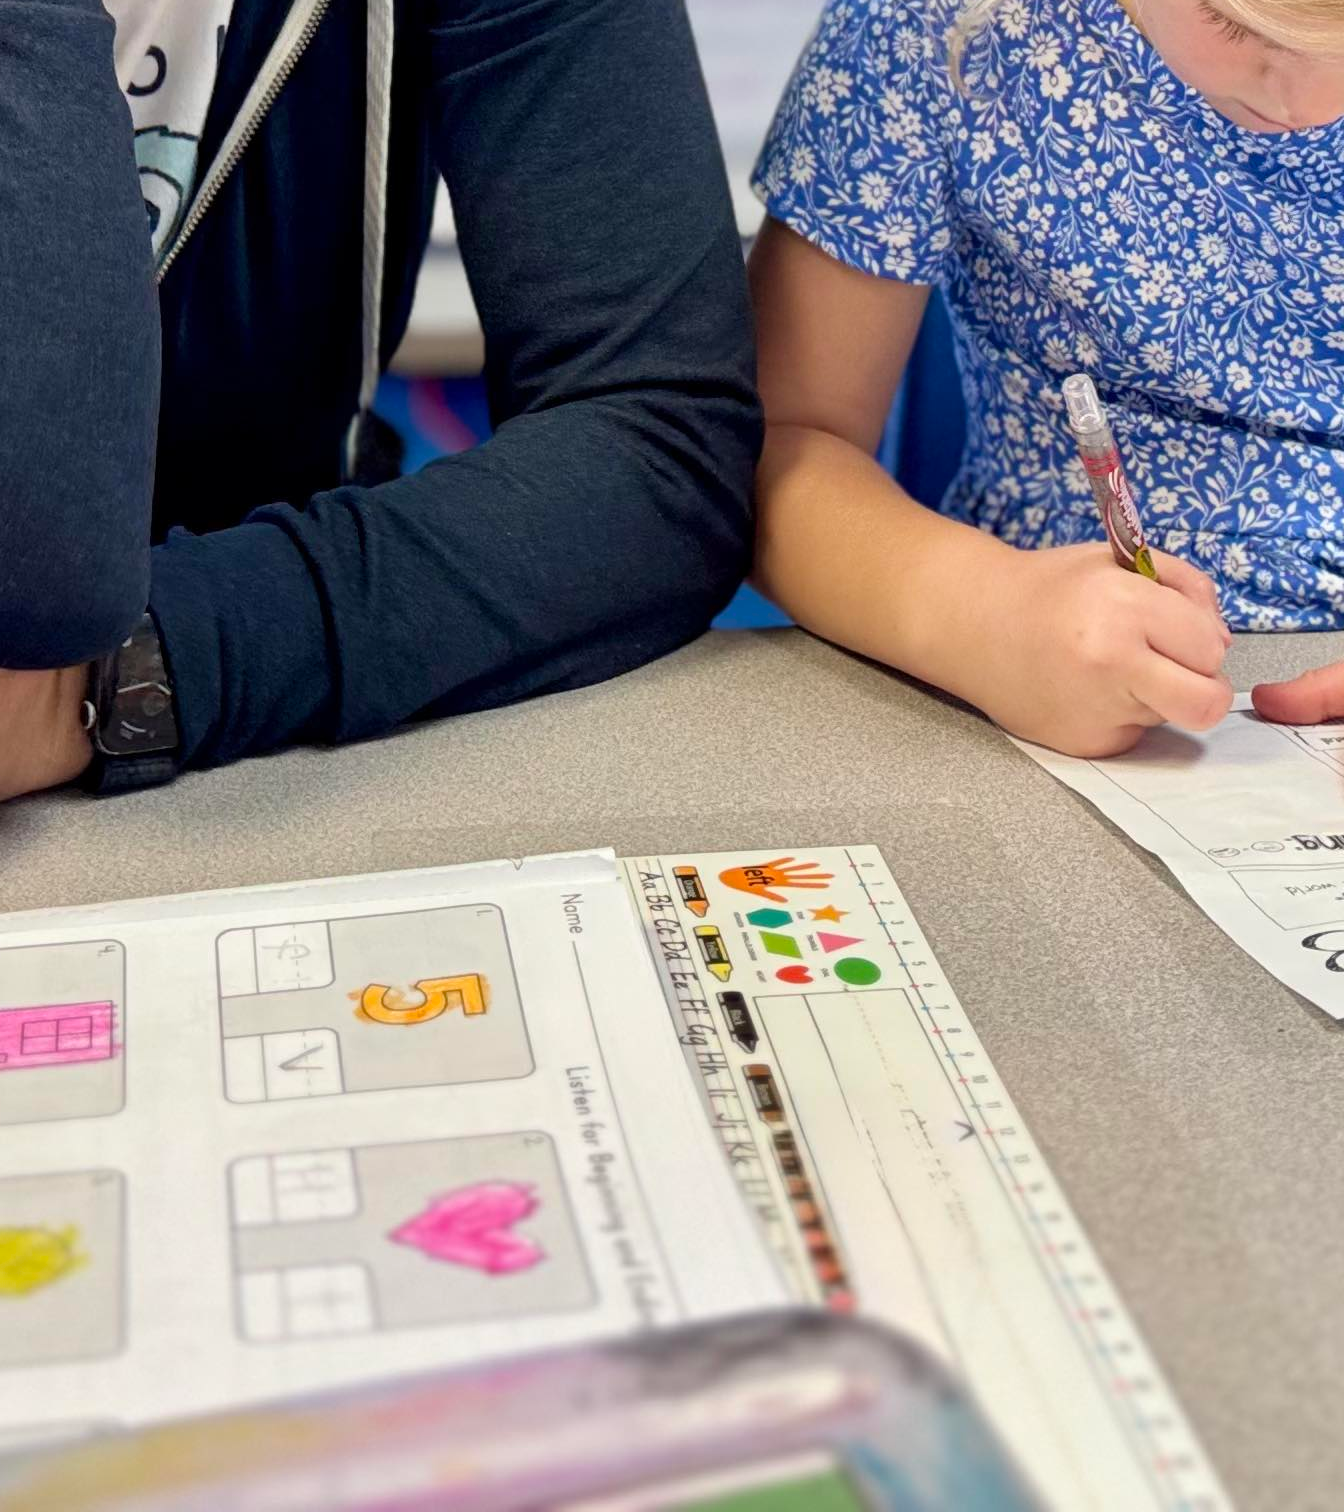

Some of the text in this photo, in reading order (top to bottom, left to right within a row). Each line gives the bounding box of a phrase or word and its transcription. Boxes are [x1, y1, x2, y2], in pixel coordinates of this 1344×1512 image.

[639, 870, 664, 890] Aa
[741, 864, 776, 887] left
[1284, 882, 1337, 898] world
[559, 892, 584, 935] Name
[646, 895, 674, 912] Bb
[653, 918, 681, 936] Cc
[660, 941, 691, 962] Dd
[670, 971, 699, 990] Ee
[678, 999, 711, 1015] Ff
[679, 1024, 718, 1047] Gg
[696, 1052, 730, 1076] Hh
[564, 1065, 596, 1117] Listen
[711, 1113, 749, 1129] Jj
[578, 1121, 606, 1147] for
